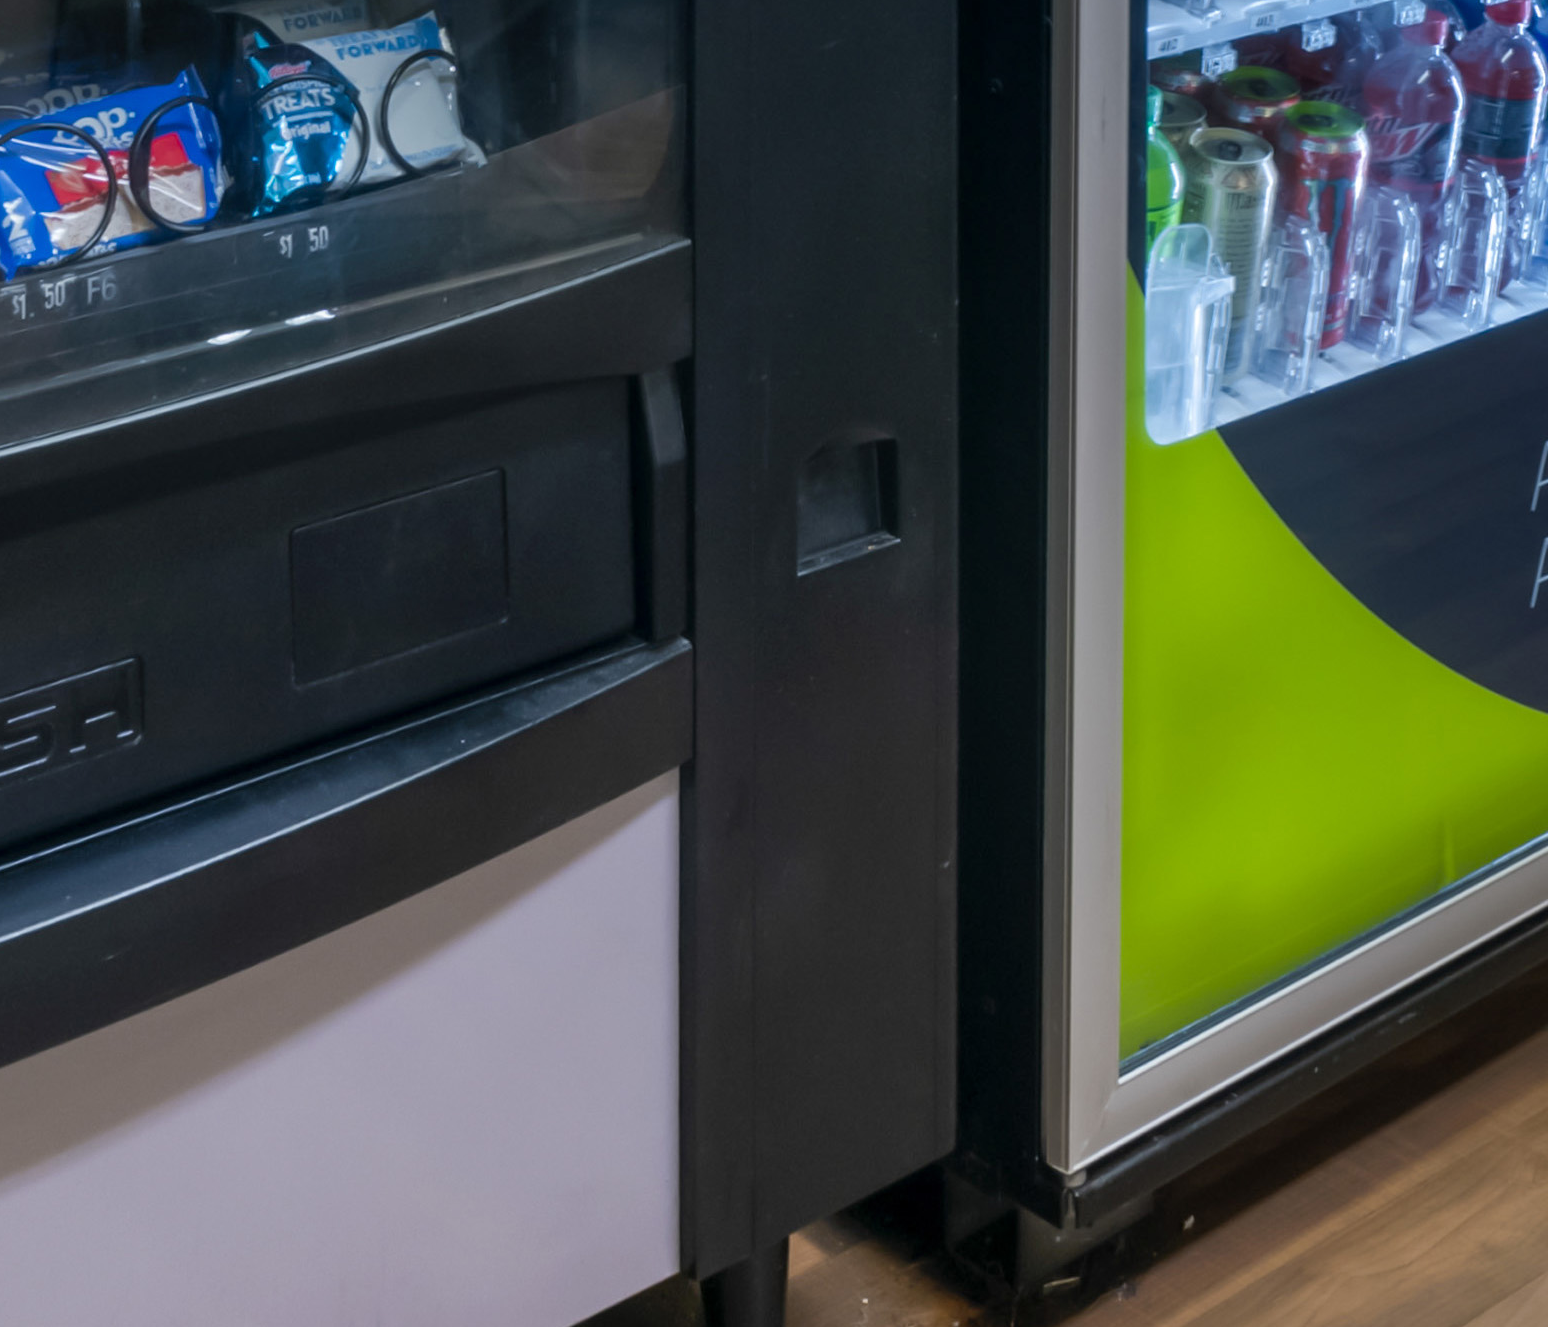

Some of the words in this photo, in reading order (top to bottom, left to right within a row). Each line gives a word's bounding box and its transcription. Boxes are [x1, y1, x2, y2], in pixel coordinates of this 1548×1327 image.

[335, 33, 419, 61] FORWARD
[261, 87, 337, 120] TREATS
[86, 275, 117, 305] F6
